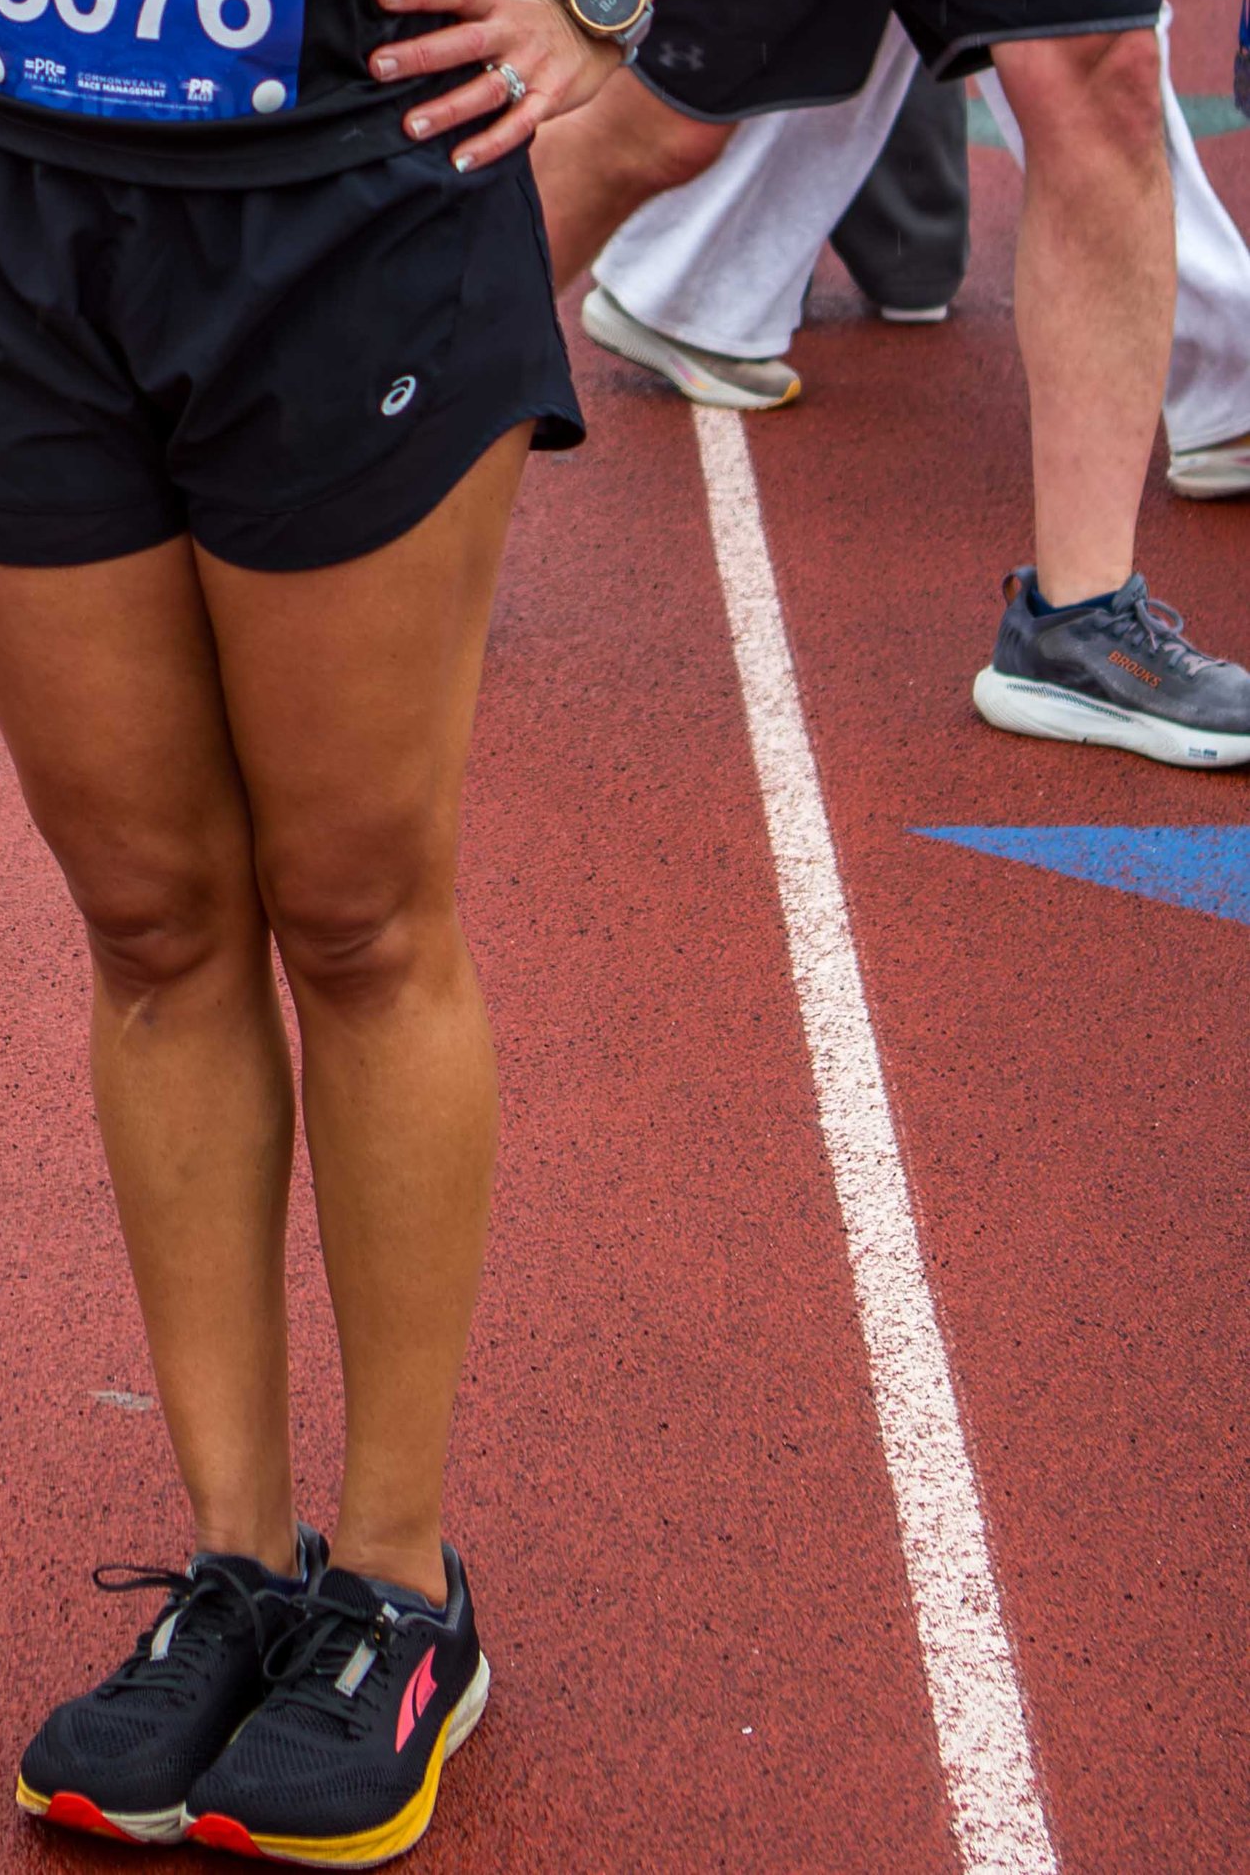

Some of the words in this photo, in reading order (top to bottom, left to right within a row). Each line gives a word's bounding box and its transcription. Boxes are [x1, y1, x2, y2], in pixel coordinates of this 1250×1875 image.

[78, 72, 166, 88] COMMONWEALTH
[78, 80, 100, 91] RACE
[102, 84, 165, 98] MANAGEMENT
[1108, 650, 1162, 687] BROOKS
